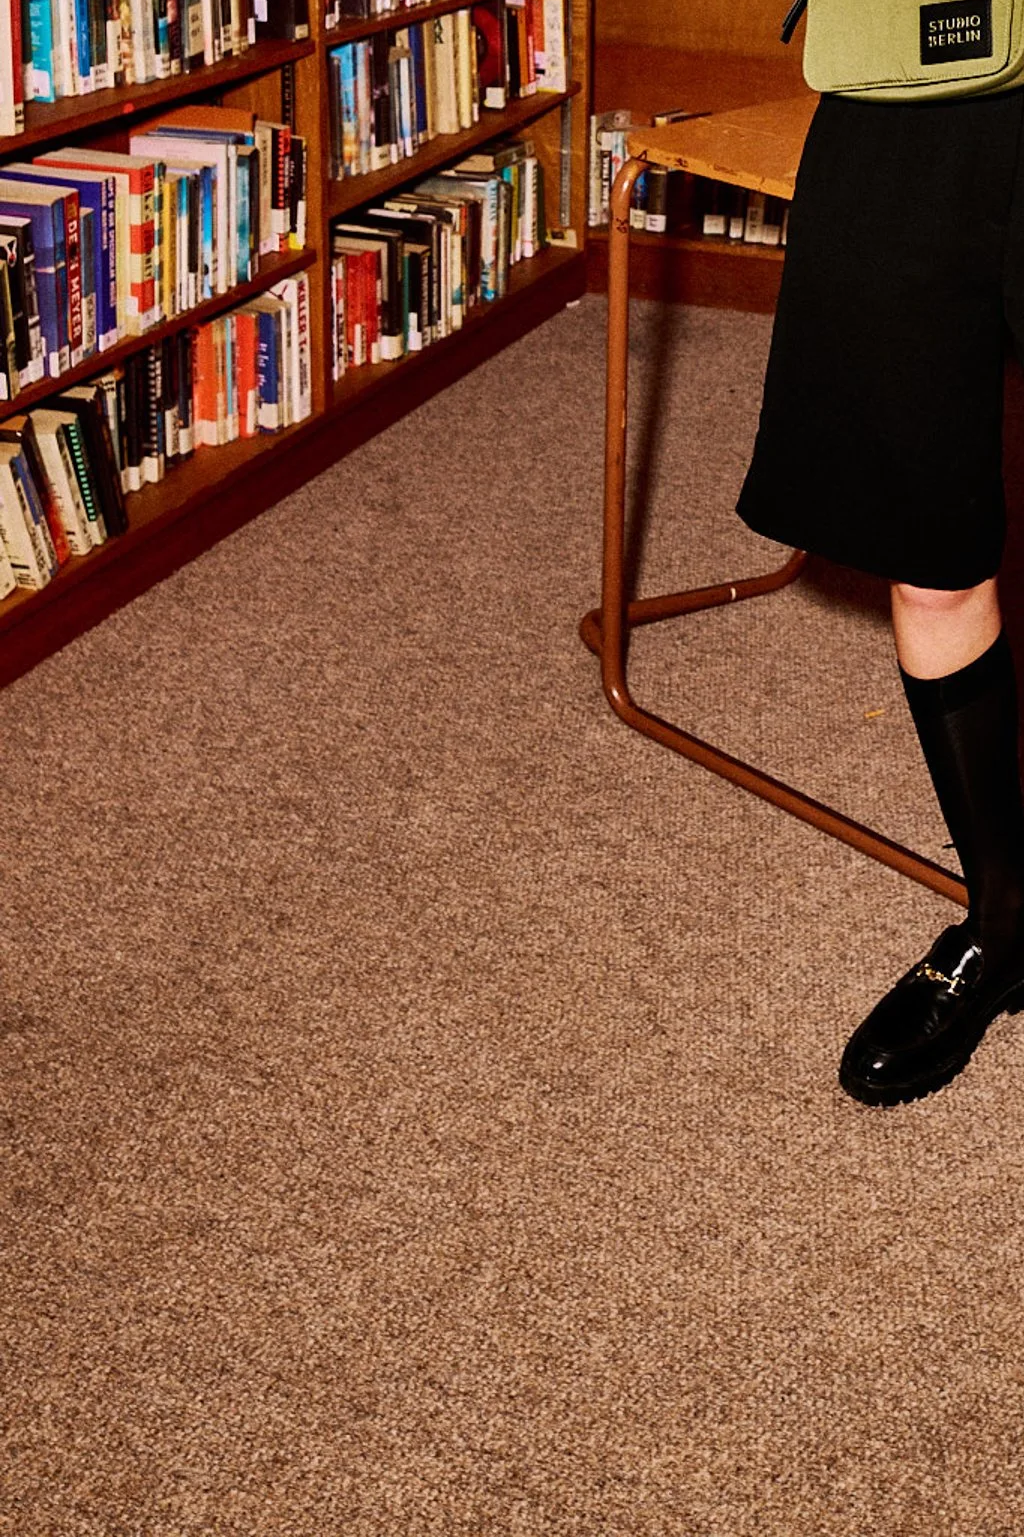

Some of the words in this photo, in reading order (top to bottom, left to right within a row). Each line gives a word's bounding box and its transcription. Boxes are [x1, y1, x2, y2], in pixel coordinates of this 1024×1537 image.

[928, 14, 981, 33] STUDIO
[928, 29, 981, 48] BERLIN
[70, 277, 81, 336] MEYER
[297, 283, 307, 335] KILLER
